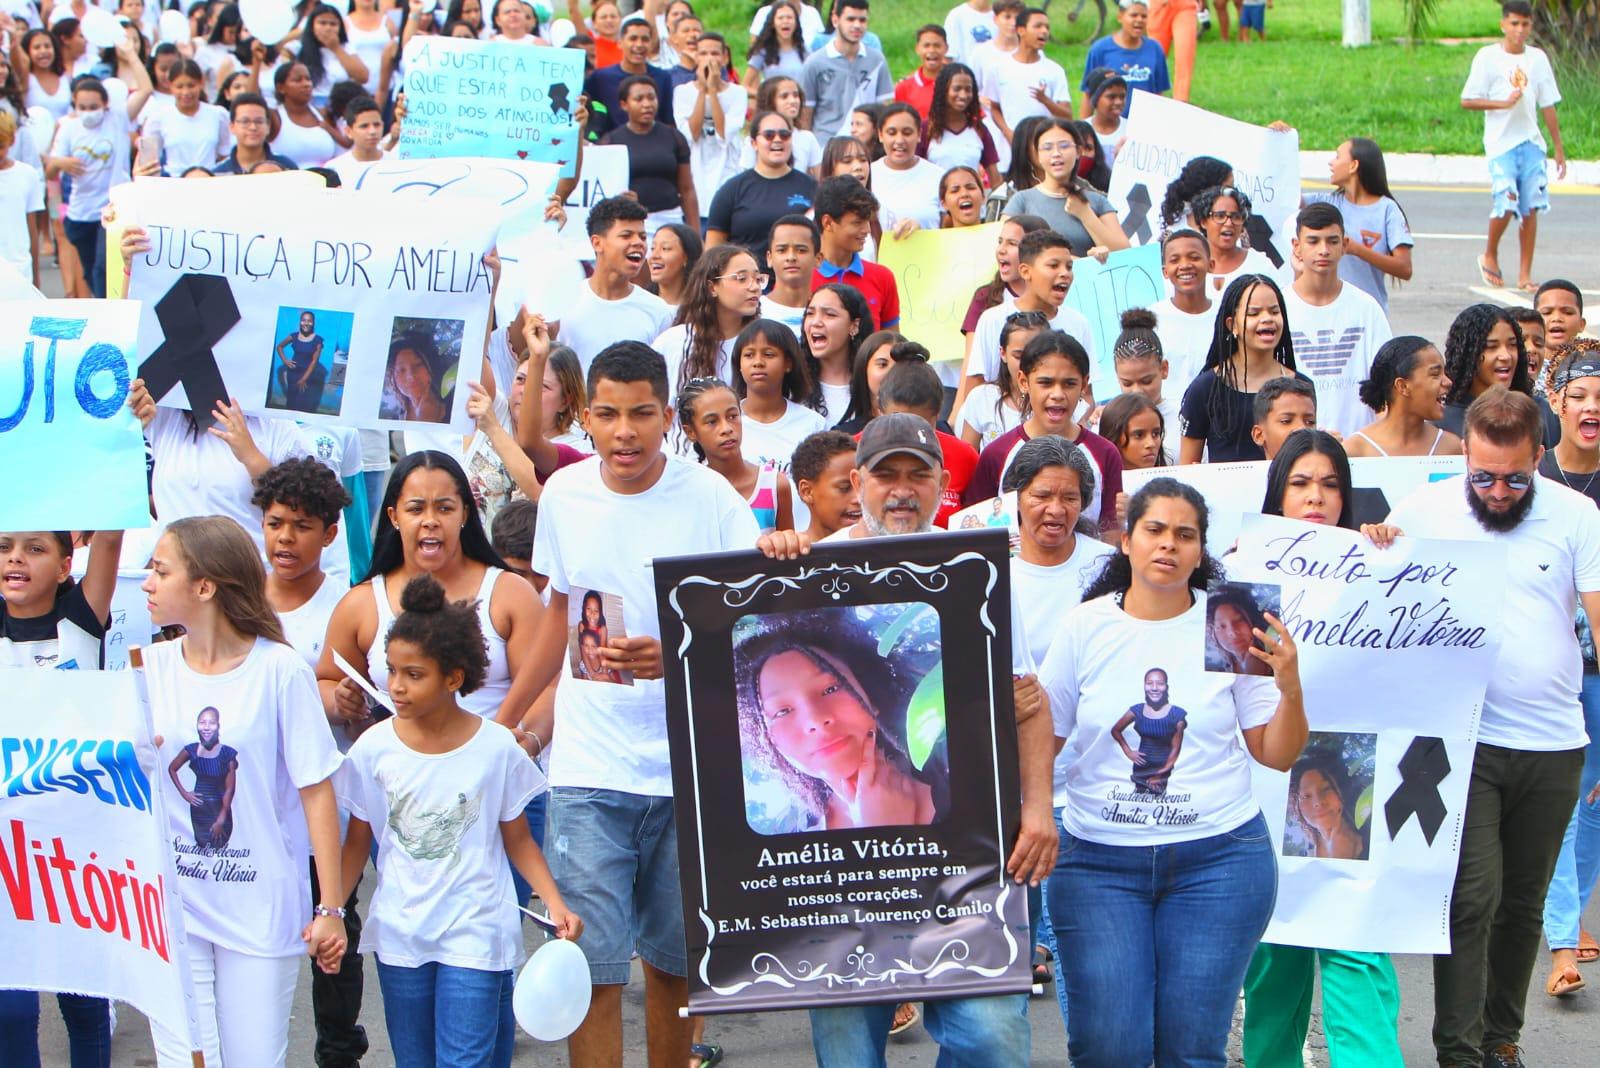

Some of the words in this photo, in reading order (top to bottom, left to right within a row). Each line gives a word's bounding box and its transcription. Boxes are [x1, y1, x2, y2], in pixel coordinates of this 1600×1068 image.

[440, 51, 527, 78] JUSTIÇA
[539, 61, 578, 80] TEM
[409, 70, 449, 95] QUE
[458, 78, 508, 99] ESTAR
[520, 87, 544, 102] DO
[406, 99, 447, 117] LADO
[458, 106, 488, 120] DOS
[506, 127, 541, 142] LUTO
[145, 225, 291, 283] JUSTIÇA
[312, 241, 372, 288] POR
[388, 240, 492, 294] AMÉLIA
[0, 316, 131, 432] UTO
[1265, 530, 1372, 584] Luto
[1378, 561, 1458, 598] por
[1386, 597, 1487, 650] Vitória
[1101, 803, 1149, 825] Amélia
[1152, 804, 1199, 825] Vitória
[757, 843, 845, 867] Amélia
[852, 837, 948, 860] Vitória,
[212, 859, 257, 882] Vitória
[740, 873, 777, 890] você
[782, 869, 832, 886] estará
[838, 871, 874, 887] para
[878, 866, 938, 883] sempre
[942, 864, 967, 876] em
[787, 893, 842, 907] nossos
[847, 888, 923, 904] corações.
[718, 917, 756, 934] E.M.
[761, 911, 849, 930] Sebastiana
[854, 907, 932, 924] Lourenço
[935, 901, 993, 919] Camilo
